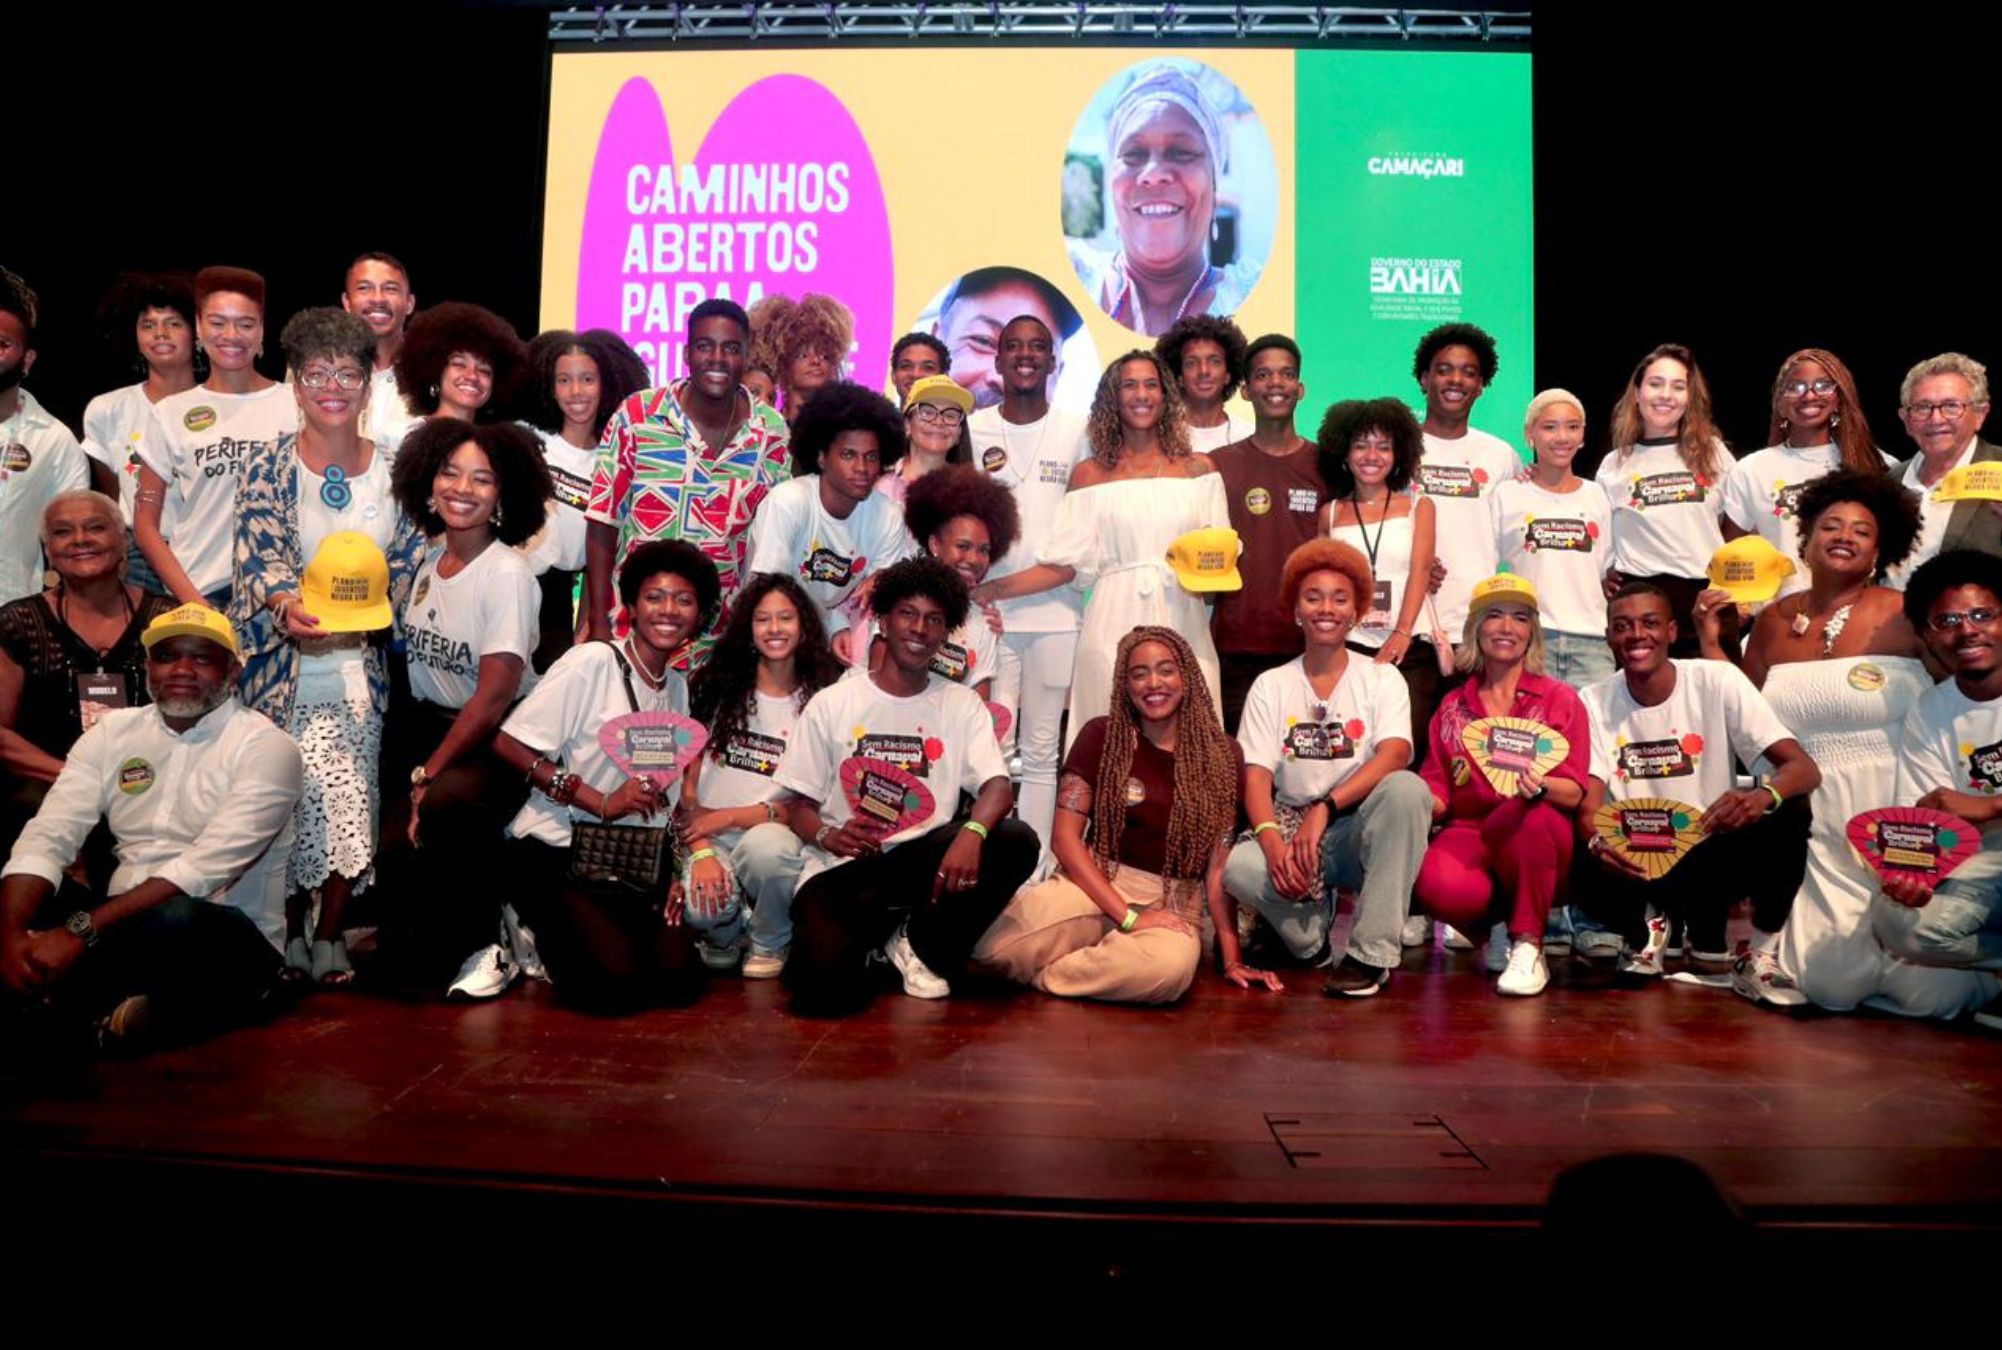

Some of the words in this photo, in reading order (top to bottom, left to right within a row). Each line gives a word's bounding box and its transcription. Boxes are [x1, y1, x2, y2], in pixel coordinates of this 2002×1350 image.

[1367, 157, 1464, 180] CAMAÇARI
[627, 162, 850, 215] CAMINHOS
[622, 221, 819, 273] ABERTOS
[1370, 267, 1462, 294] BAHIA
[204, 462, 226, 478] DO
[1423, 475, 1473, 488] Carnaval
[1642, 482, 1696, 497] Carnaval
[1534, 527, 1586, 541] Carnaval
[883, 739, 921, 750] Racismo
[1626, 750, 1682, 767] Carnaval
